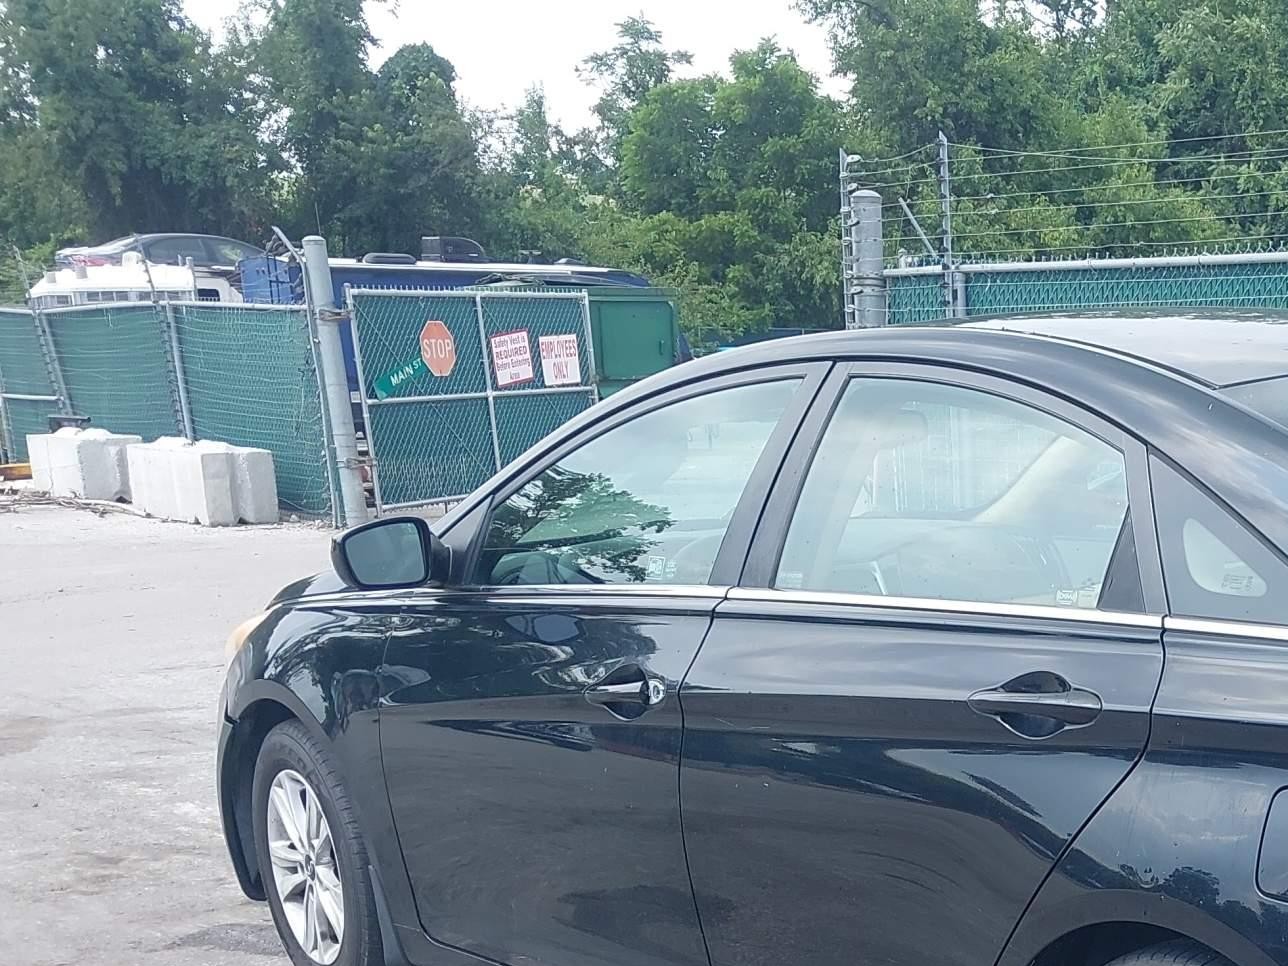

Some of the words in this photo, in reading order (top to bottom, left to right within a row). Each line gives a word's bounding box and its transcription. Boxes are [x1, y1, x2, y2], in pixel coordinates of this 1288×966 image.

[423, 339, 452, 359] STOP
[494, 337, 509, 349] Safety
[510, 336, 520, 346] Vest
[541, 339, 577, 360] EMPLOYEES
[496, 346, 528, 360] REQUIRED
[390, 364, 414, 387] MAIN
[413, 358, 422, 369] ST
[496, 361, 510, 372] Before
[511, 358, 530, 368] Entering
[553, 361, 569, 380] ONLY
[510, 370, 521, 380] Area
